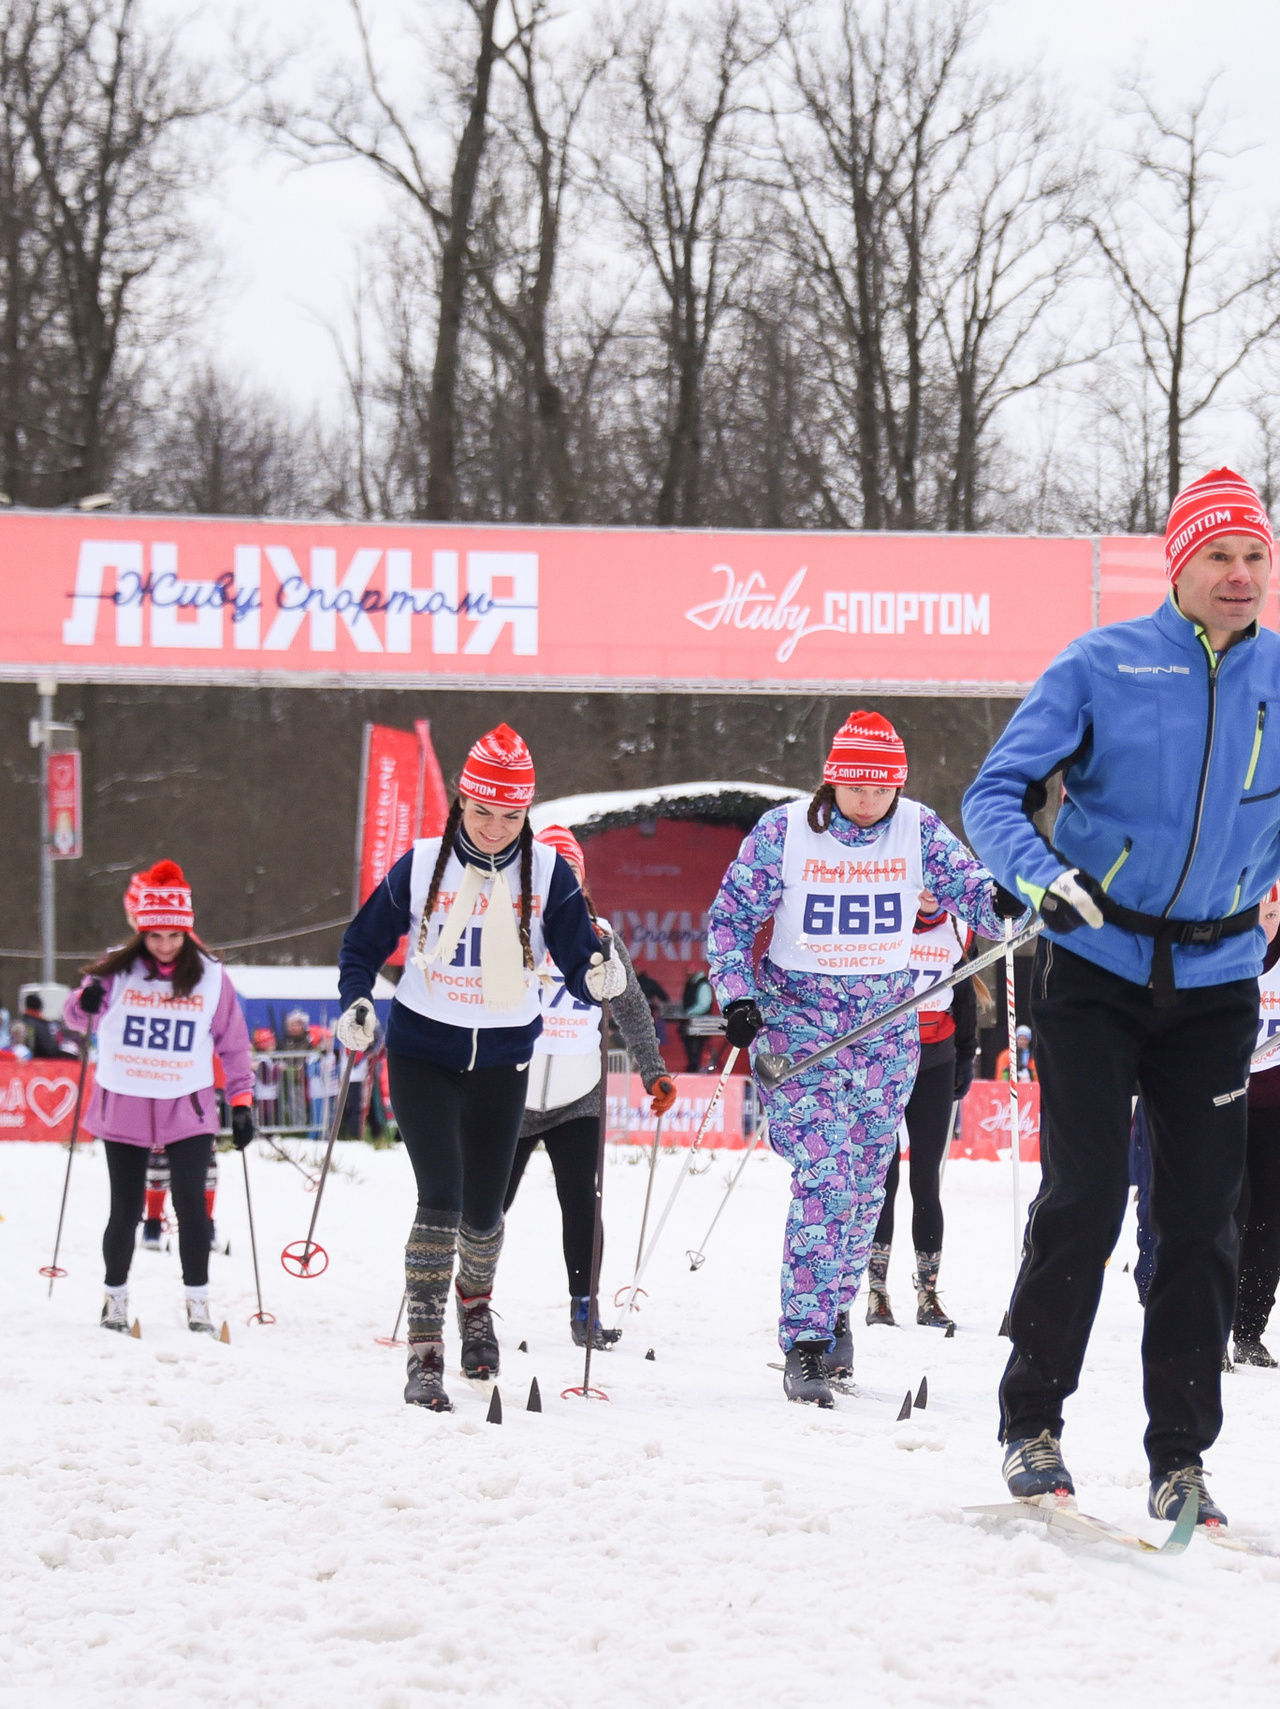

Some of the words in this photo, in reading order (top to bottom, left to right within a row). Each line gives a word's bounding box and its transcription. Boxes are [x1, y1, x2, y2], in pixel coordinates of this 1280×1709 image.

[1170, 509, 1231, 556] СПОРТОМ
[62, 538, 539, 656] ЛЫЖНЯ
[112, 571, 263, 623] Живу
[277, 575, 496, 626] Спортом
[685, 563, 846, 663] Живу
[823, 591, 990, 635] СПОРТОМ
[1118, 664, 1190, 675] SPINE
[838, 768, 888, 779] СПОРТОМ
[802, 858, 906, 884] ЛЫЖНЯ
[803, 892, 902, 935] 669
[803, 939, 904, 953] ОСКОВСКАЯ
[817, 956, 885, 968] ОБЛАСТЬ
[123, 1014, 196, 1052] 680
